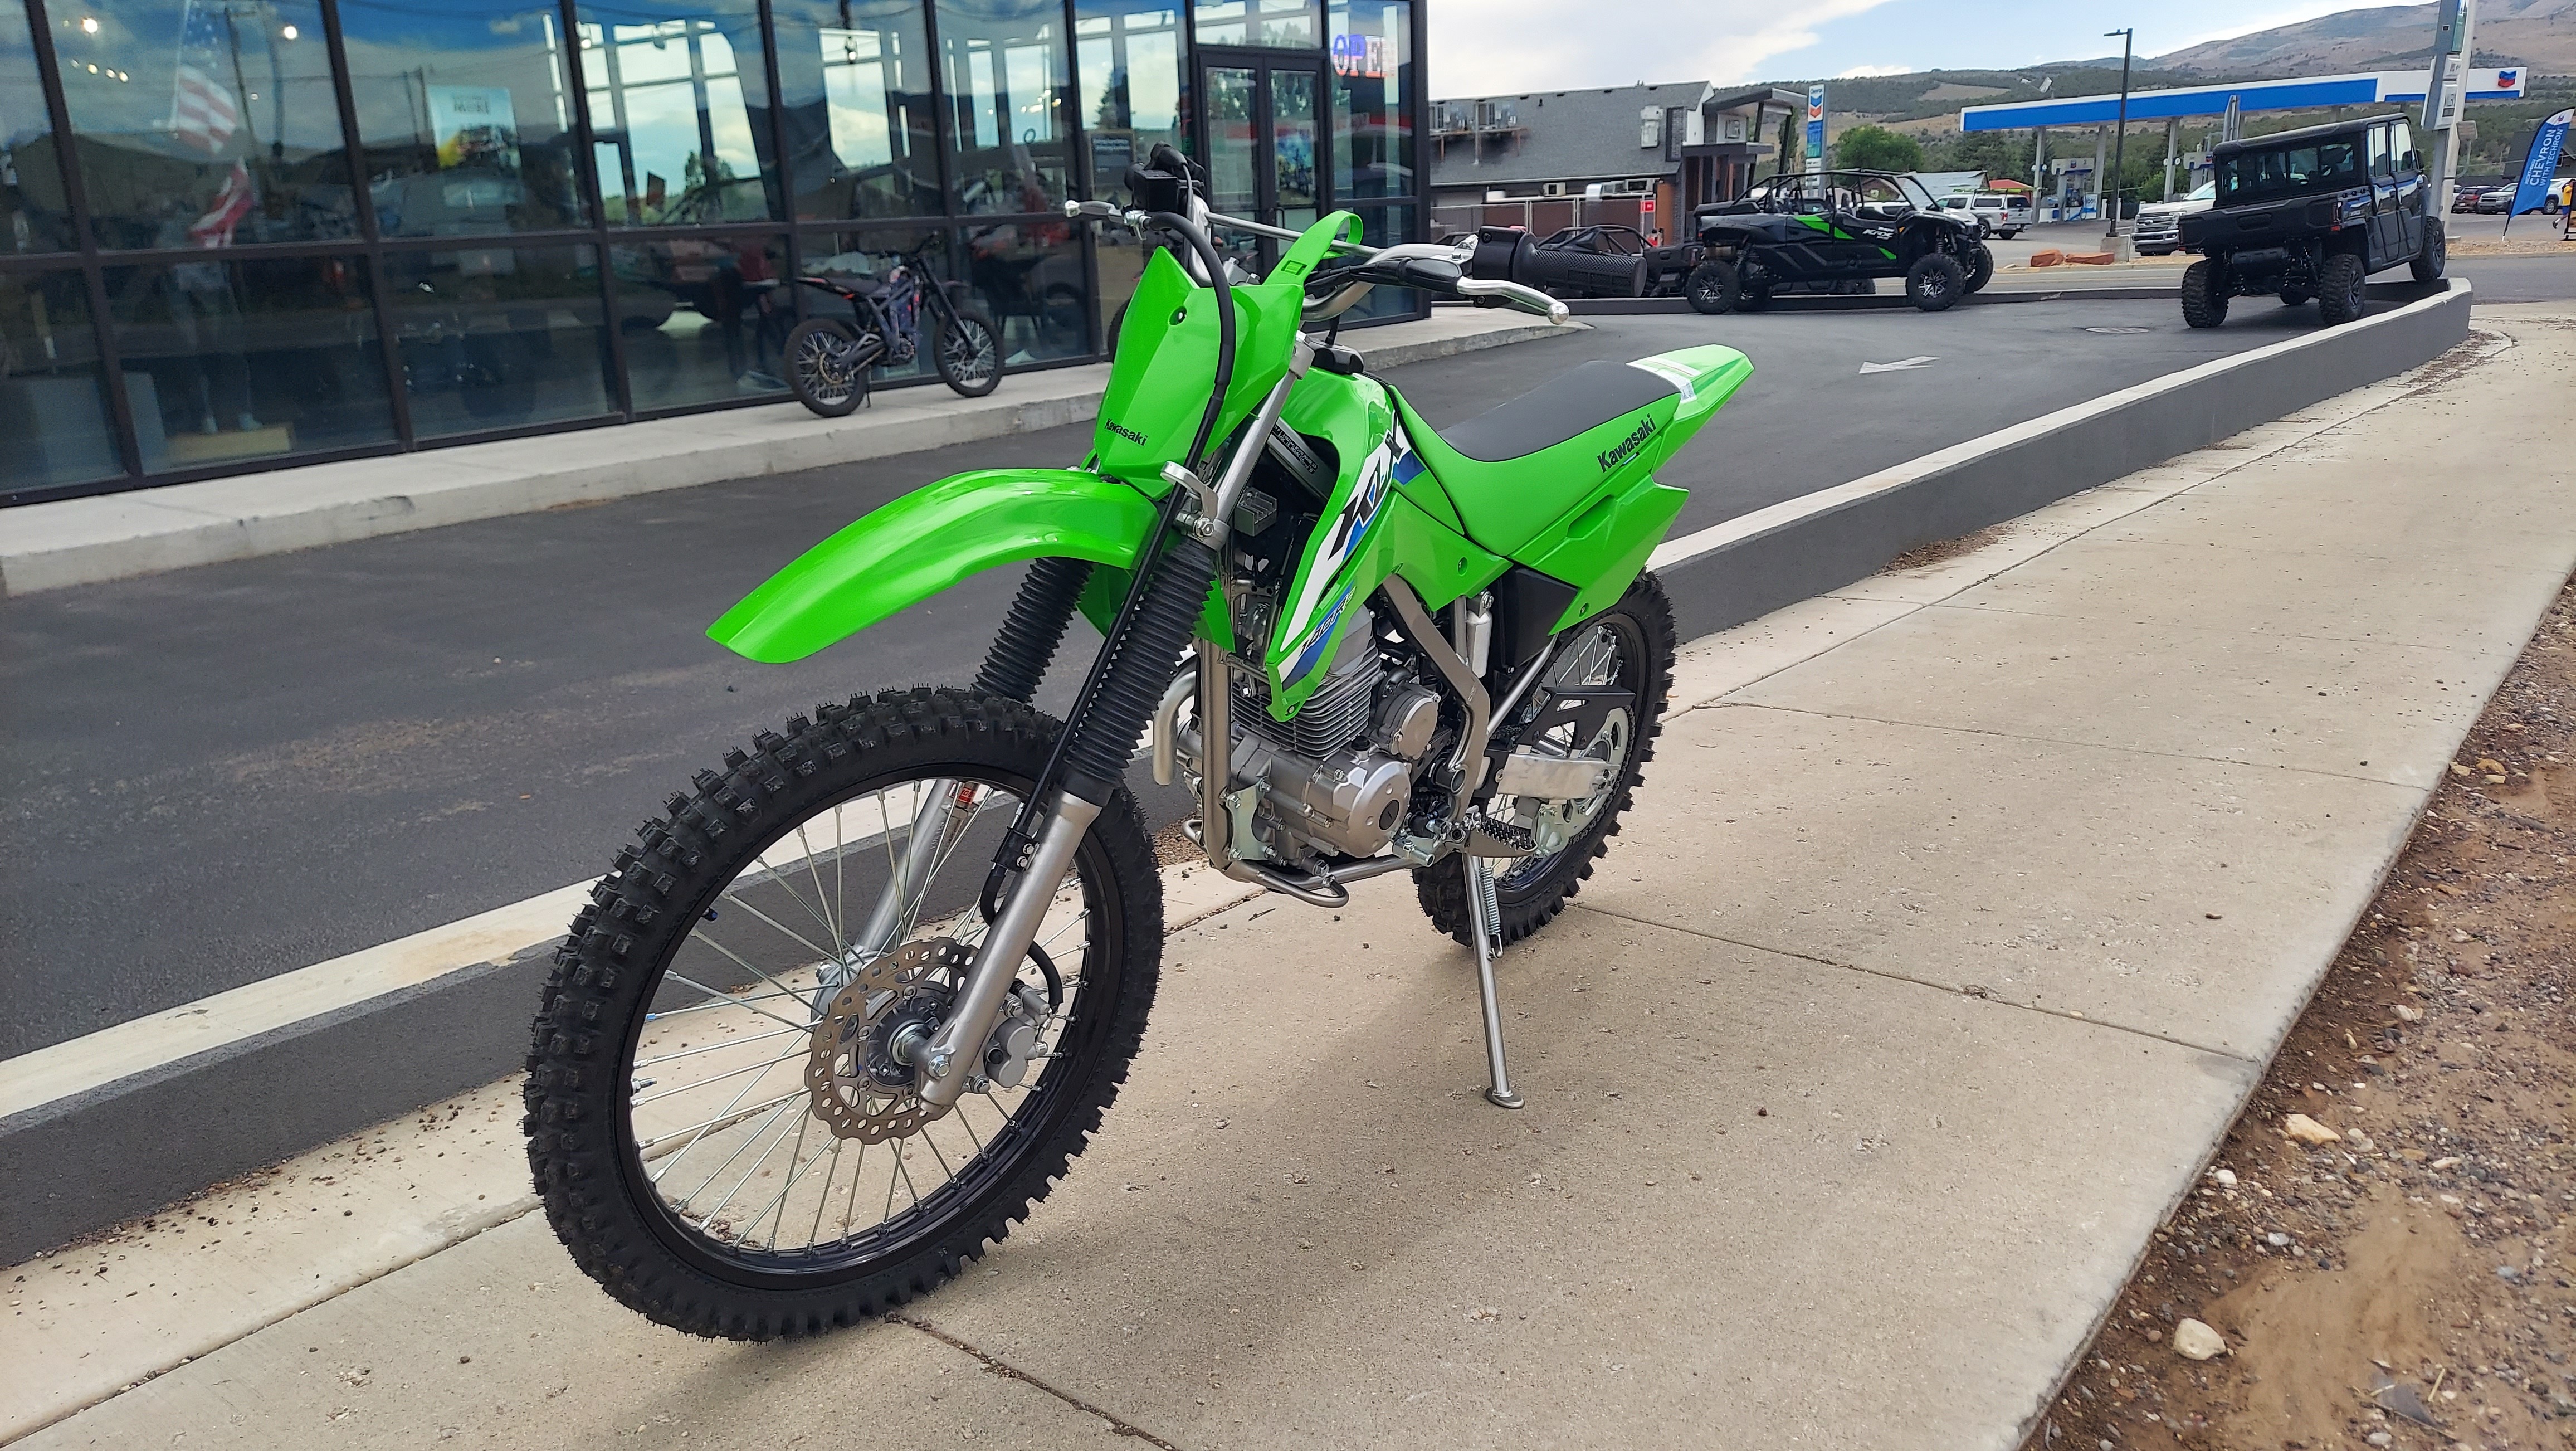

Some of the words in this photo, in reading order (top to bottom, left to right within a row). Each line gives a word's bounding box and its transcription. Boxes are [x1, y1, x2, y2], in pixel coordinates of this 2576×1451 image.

[2530, 130, 2557, 186] CHEVRON
[2540, 164, 2550, 187] WITH
[2546, 129, 2564, 164] TECHRON
[1104, 418, 1149, 446] Kawasaki
[1597, 413, 1657, 473] Kawasaki
[1327, 410, 1404, 561] KLX
